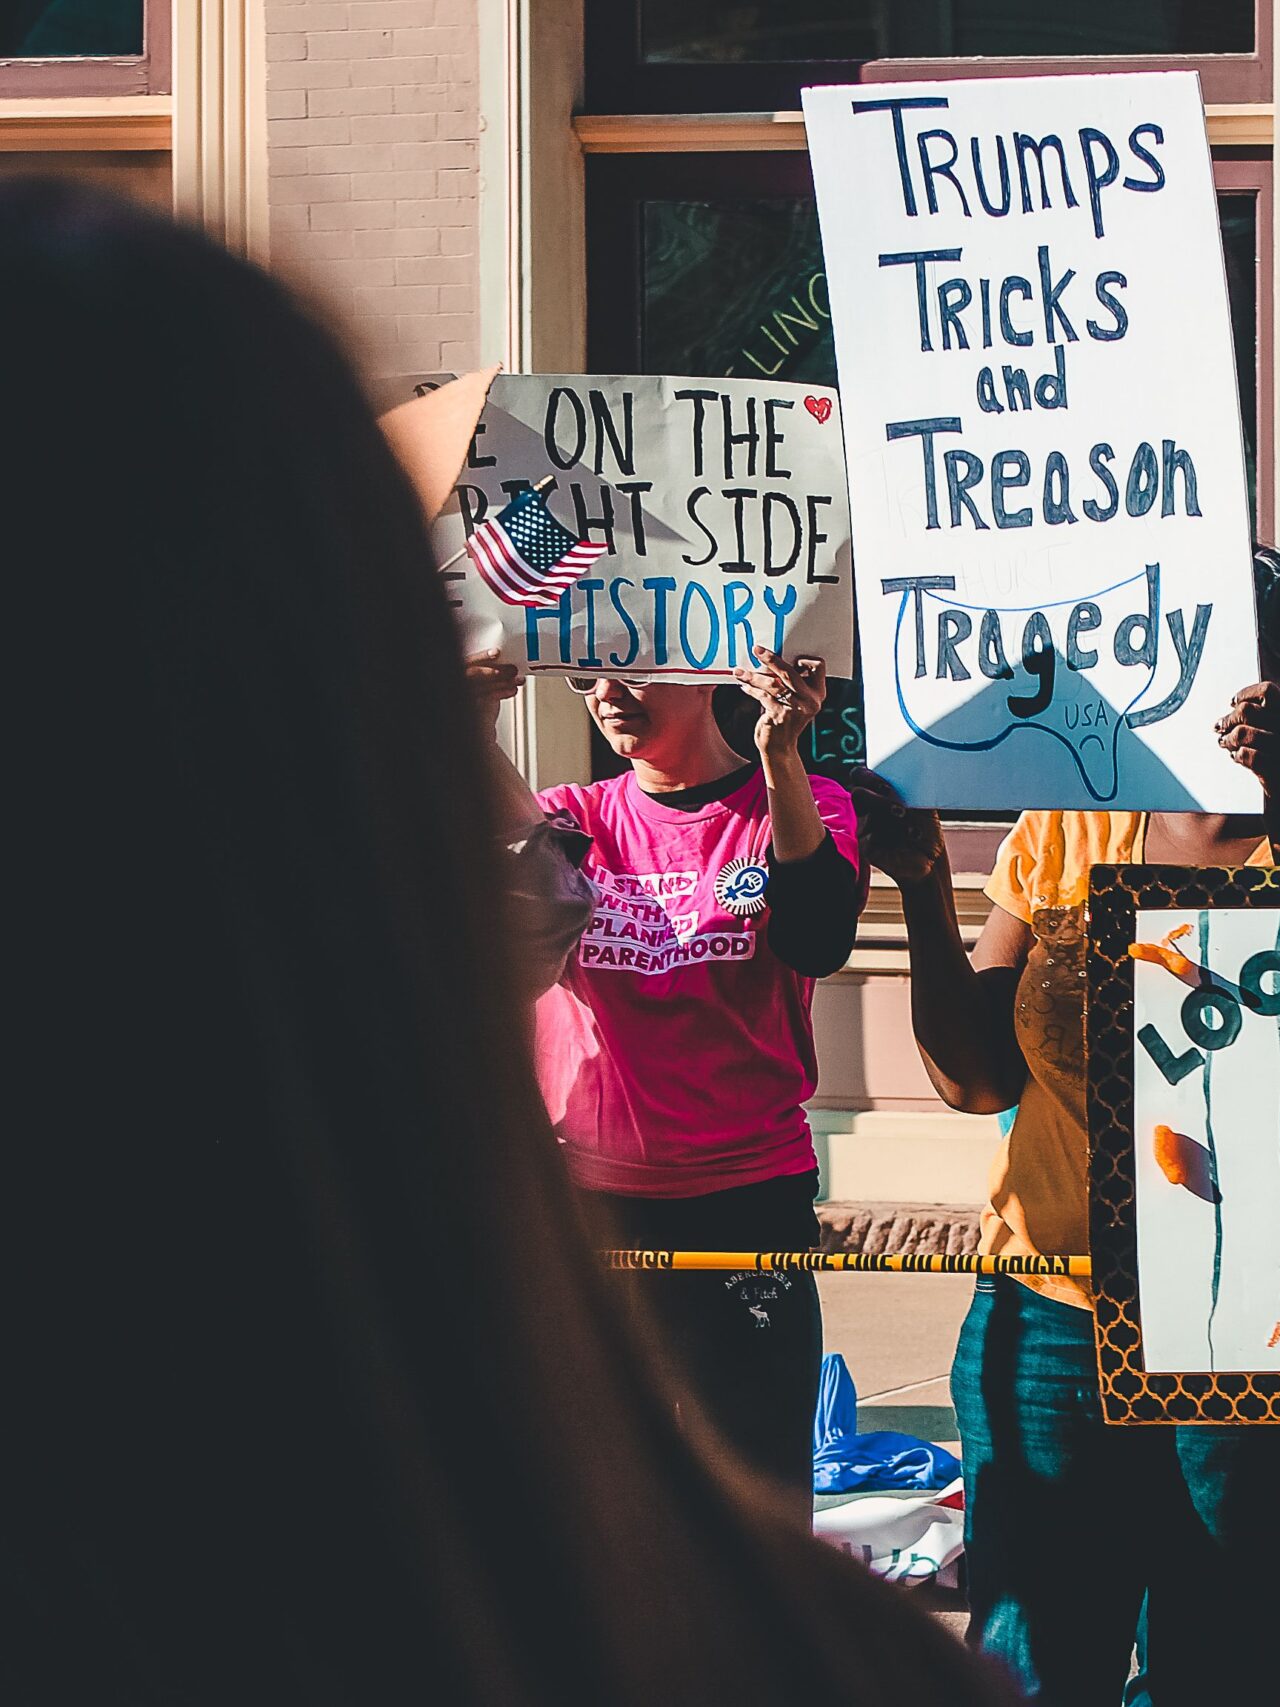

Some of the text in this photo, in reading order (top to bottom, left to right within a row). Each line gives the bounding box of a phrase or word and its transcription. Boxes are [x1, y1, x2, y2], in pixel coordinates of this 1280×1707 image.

[976, 345, 1069, 414] and
[544, 387, 635, 476] ON
[674, 389, 794, 480] THE
[456, 479, 840, 584] RHT SIDE
[526, 576, 798, 669] HISTORY
[1064, 700, 1110, 730] USA
[611, 875, 693, 897] STAND
[582, 936, 750, 972] PARENTHOOD
